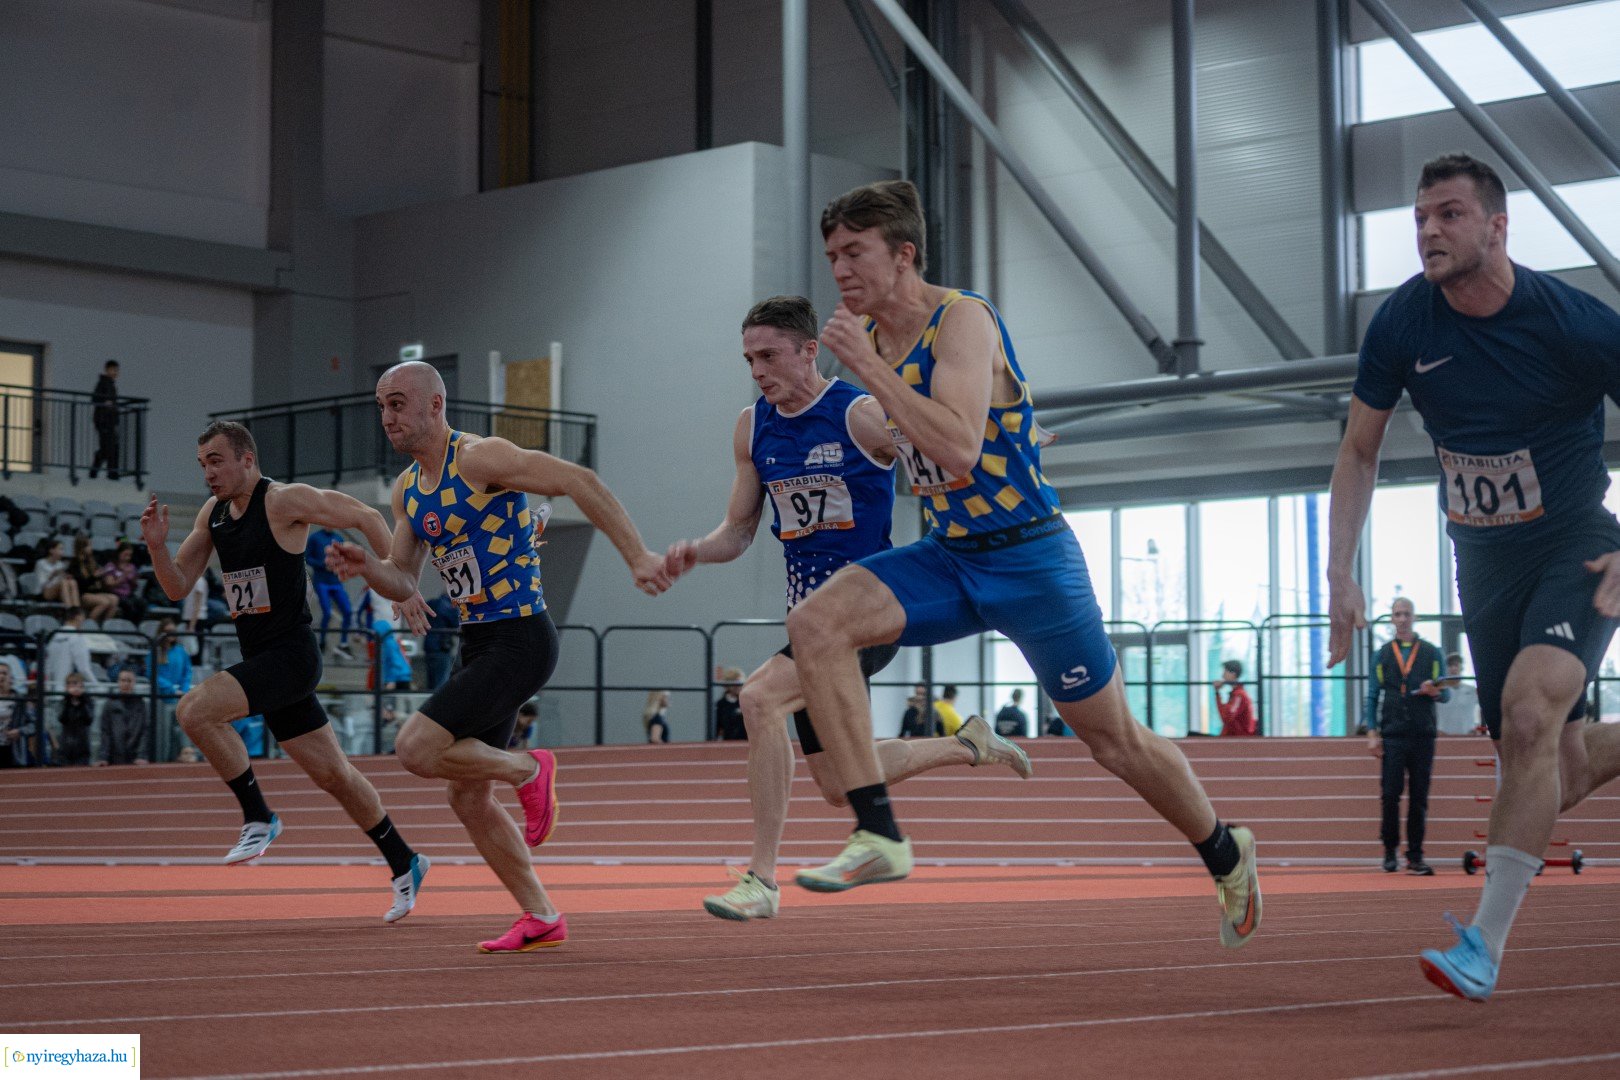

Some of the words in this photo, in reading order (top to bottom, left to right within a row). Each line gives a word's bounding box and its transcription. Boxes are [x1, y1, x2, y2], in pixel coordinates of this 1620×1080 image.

[1452, 454, 1524, 469] STABILITA
[783, 474, 837, 488] STABILITA
[1454, 472, 1527, 516] 101
[790, 489, 827, 528] 97
[795, 523, 839, 538] ATLETIKA
[232, 581, 254, 612] 21
